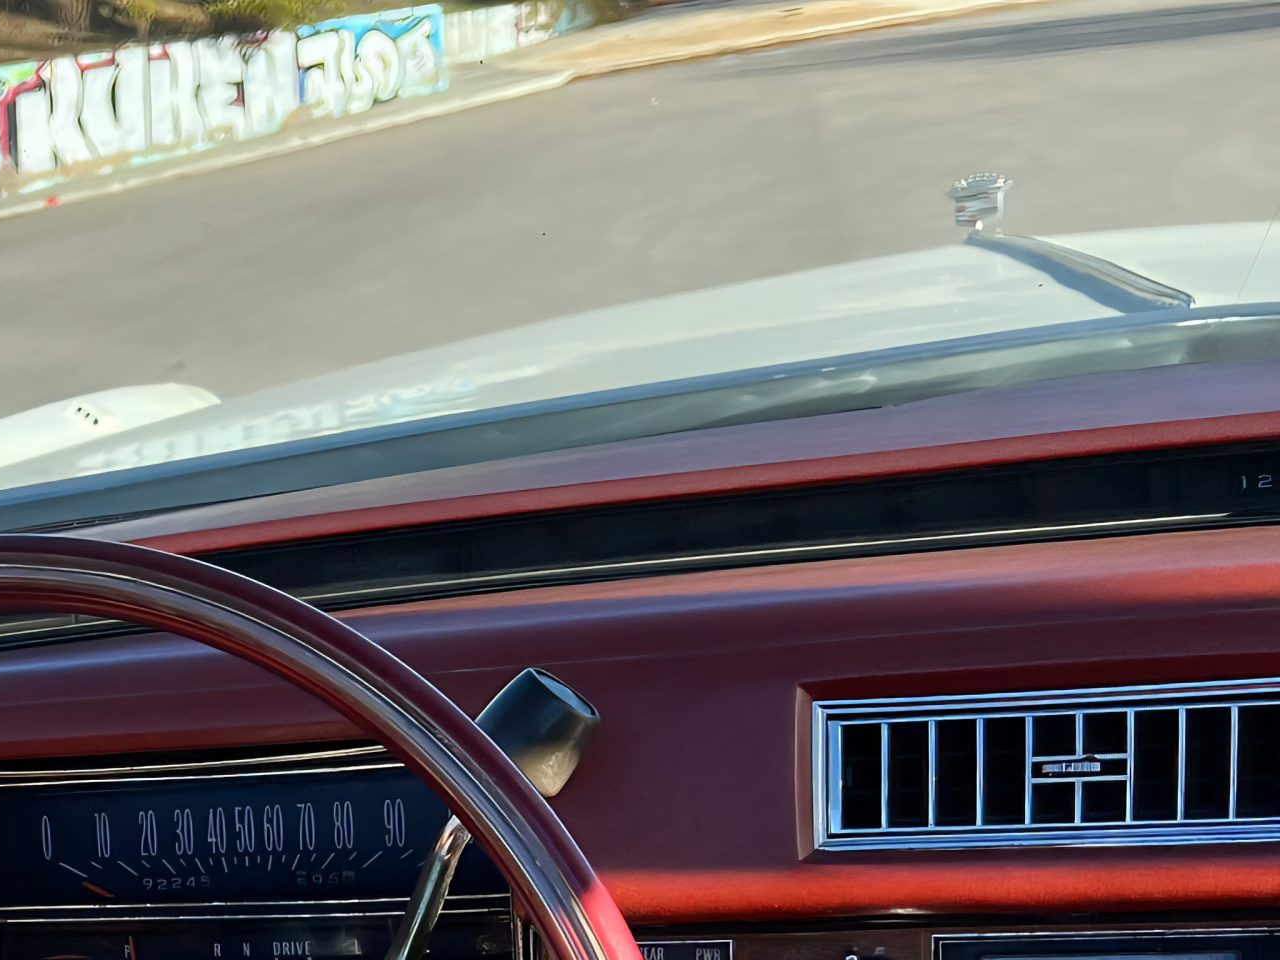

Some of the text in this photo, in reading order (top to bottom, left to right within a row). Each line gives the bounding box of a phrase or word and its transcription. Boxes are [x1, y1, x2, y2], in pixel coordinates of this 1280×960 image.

[41, 798, 406, 861] 0 10 20 30 40 50 60 70 80 90
[213, 943, 222, 957] R
[242, 942, 251, 957] N
[272, 940, 312, 957] DRIVE
[640, 946, 664, 960] EAR
